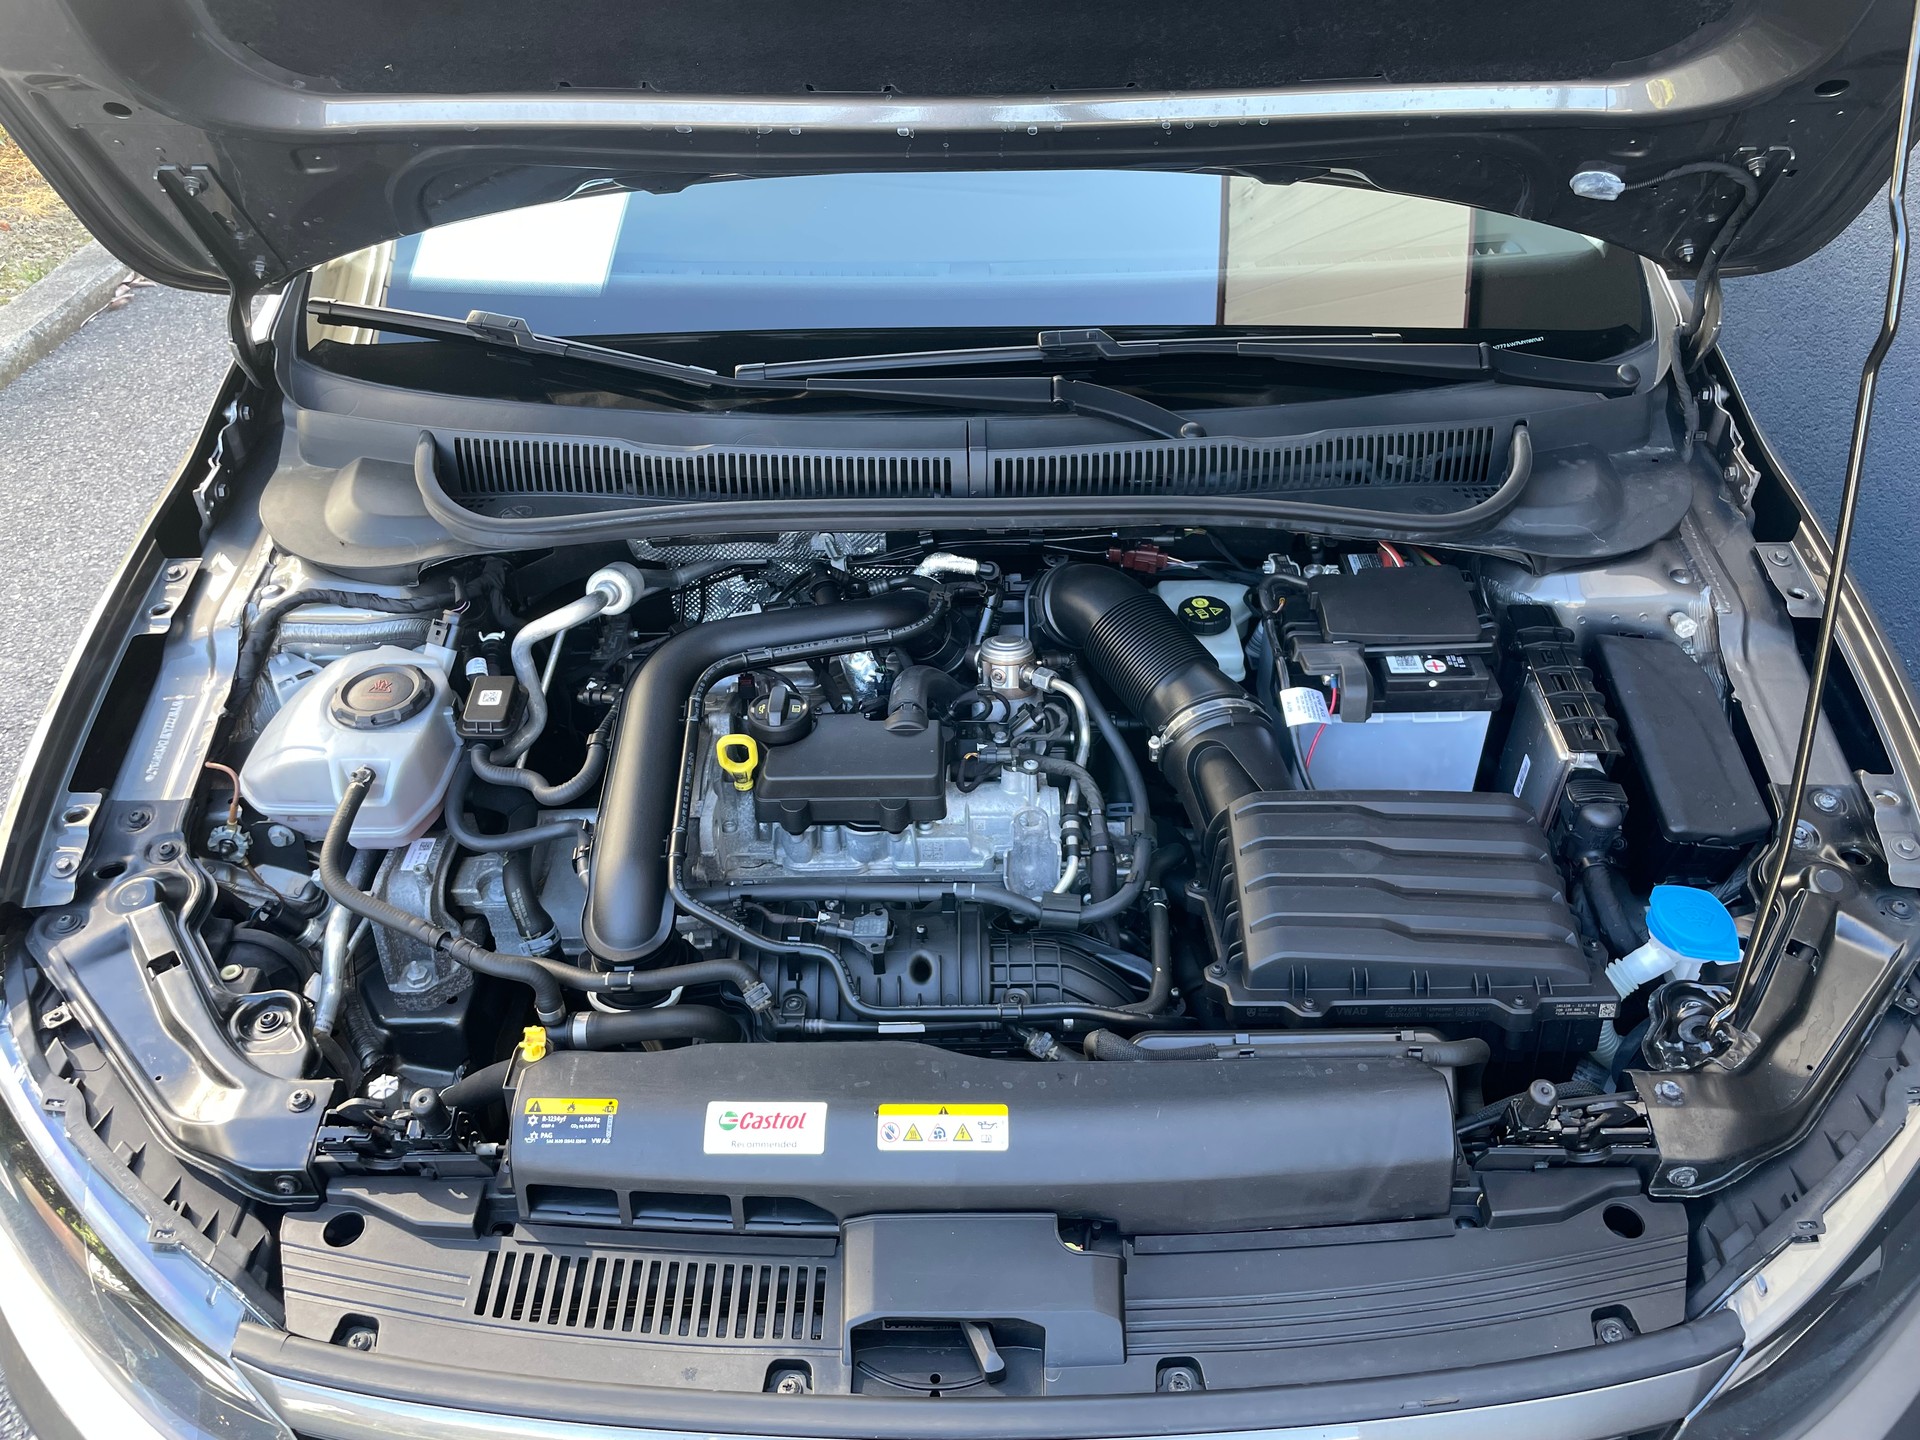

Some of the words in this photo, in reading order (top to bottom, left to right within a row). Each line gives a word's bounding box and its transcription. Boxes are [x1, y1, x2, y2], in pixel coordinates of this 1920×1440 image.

[542, 1115, 567, 1124] R-1234yf
[740, 1112, 807, 1130] Castrol
[731, 1140, 798, 1149] Recommended
